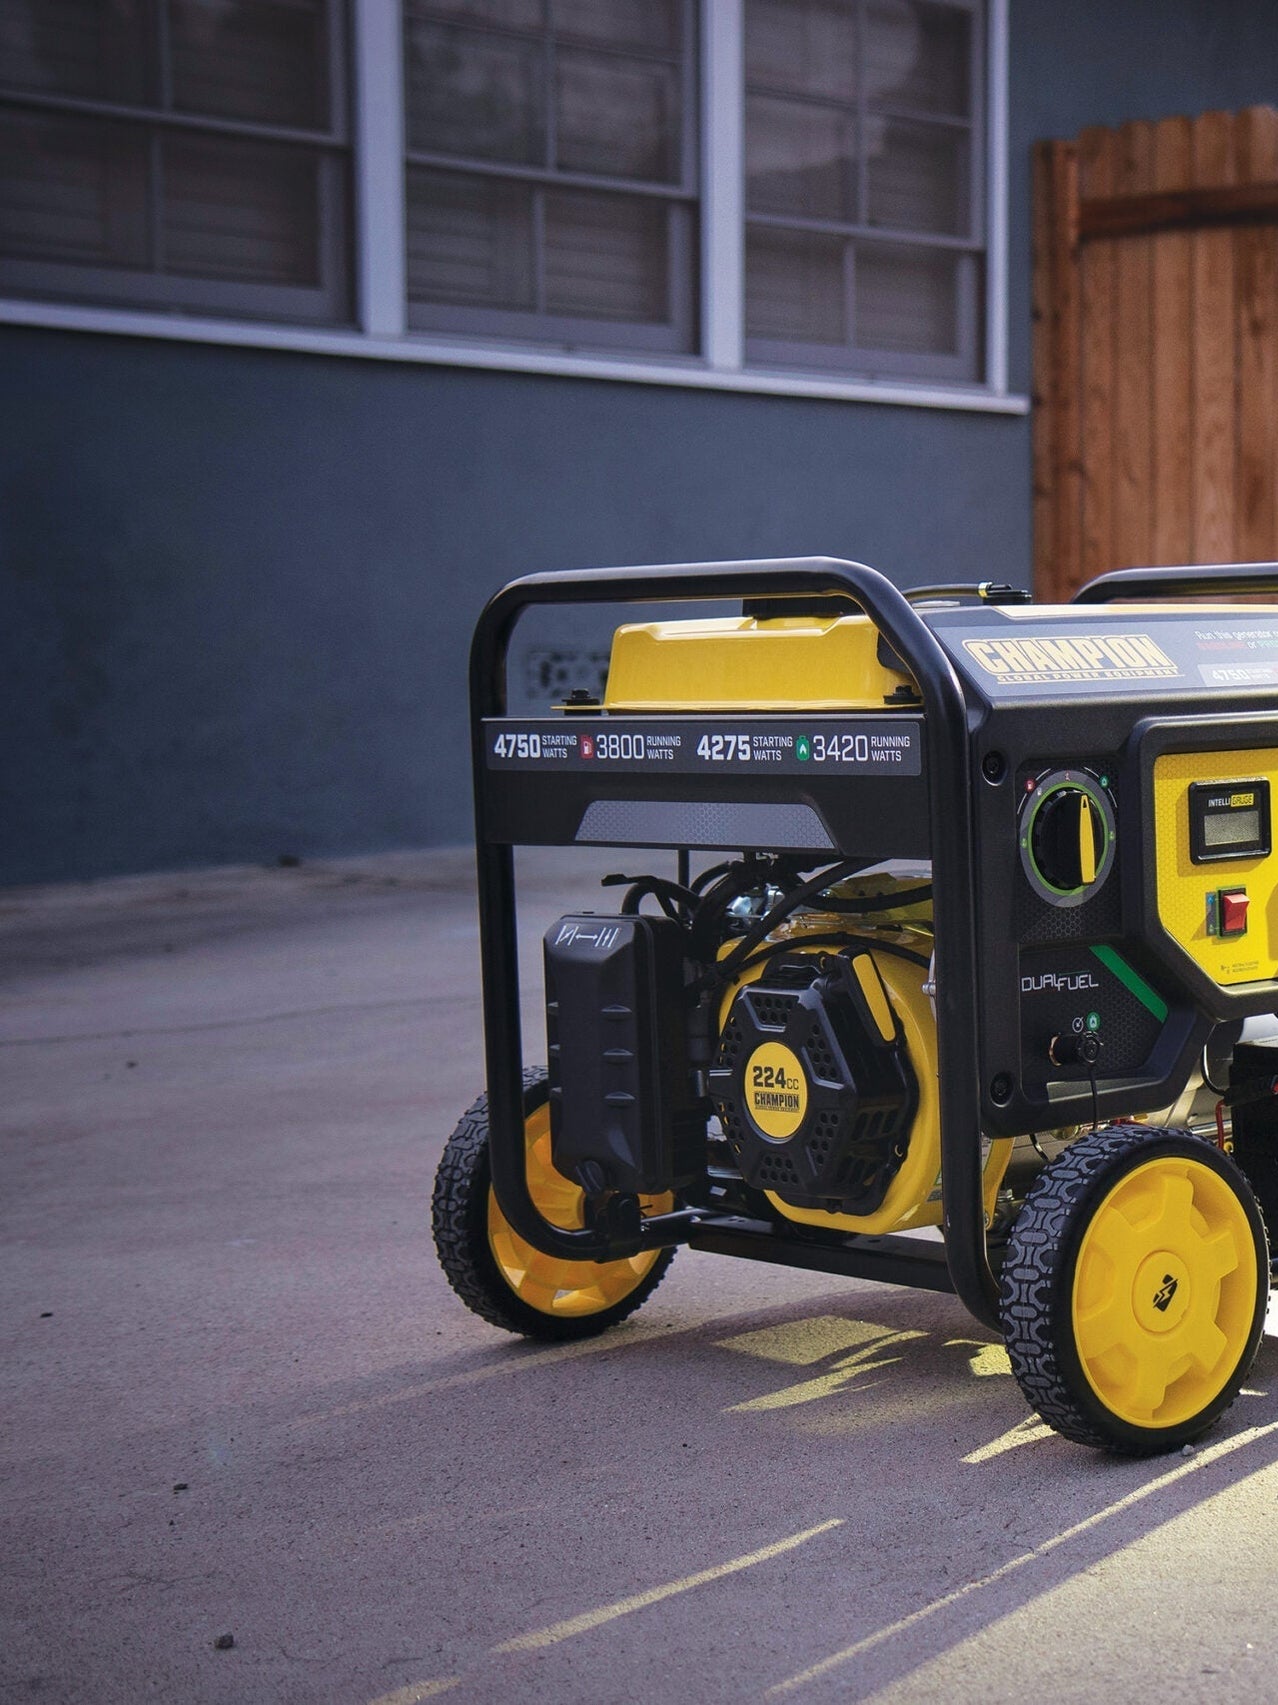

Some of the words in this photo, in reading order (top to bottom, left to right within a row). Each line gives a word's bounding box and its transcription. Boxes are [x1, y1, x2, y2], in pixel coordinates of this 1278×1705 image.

[965, 636, 1173, 674] CHAMPION
[997, 674, 1049, 683] GLOBAL
[1052, 672, 1099, 681] POWER
[1104, 669, 1179, 679] EQUIPMENT
[494, 734, 541, 758] 4750
[542, 735, 577, 746] STARTING
[646, 736, 681, 747] RUNNING
[752, 736, 793, 748] STARTING
[871, 736, 911, 748] RUNNING
[542, 748, 568, 759] WATTS
[597, 735, 645, 760] 3800
[696, 735, 750, 761] 4275
[813, 735, 869, 762] 3420
[647, 749, 674, 760] WATTS
[753, 750, 782, 761] WATTS
[871, 750, 902, 762] WATTS
[754, 1092, 799, 1109] CHAMPION
